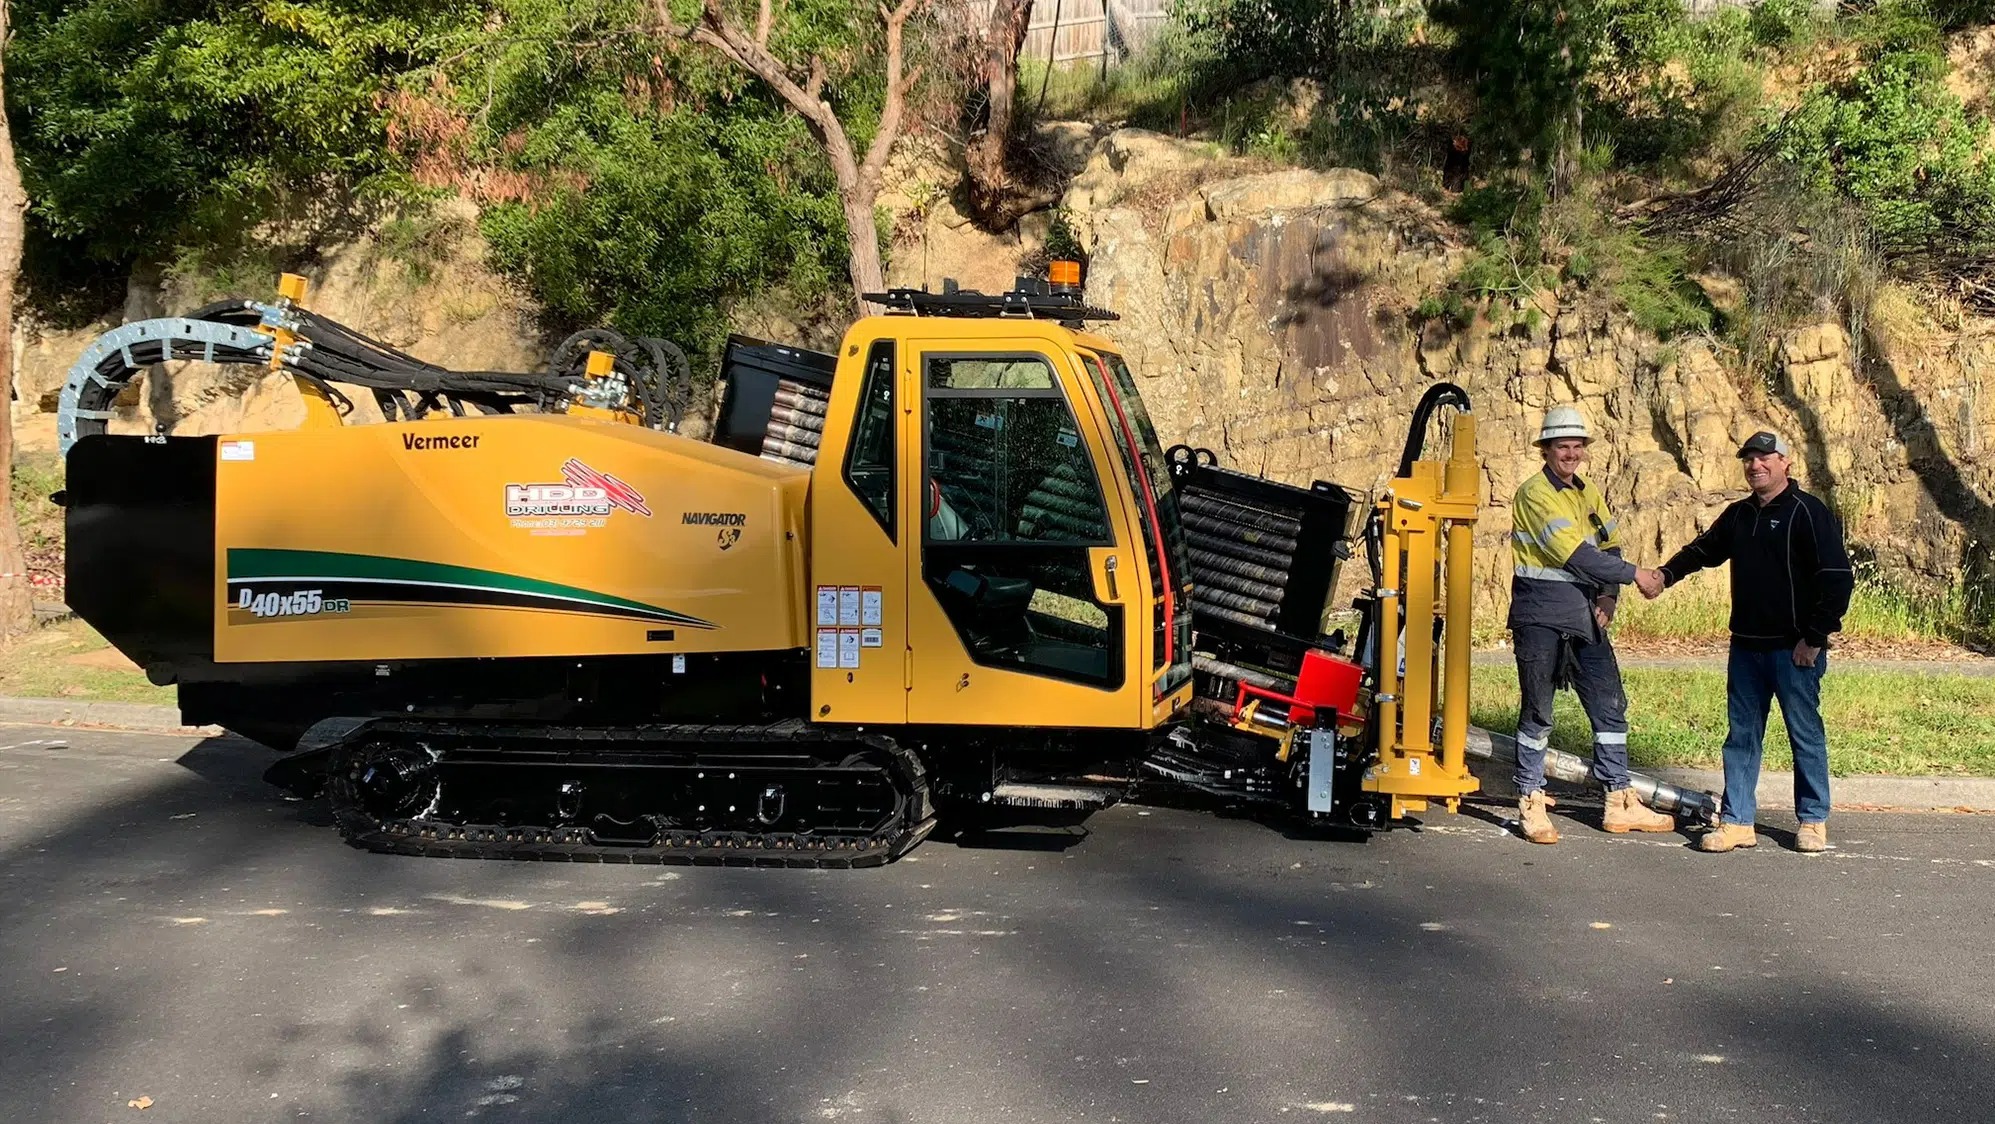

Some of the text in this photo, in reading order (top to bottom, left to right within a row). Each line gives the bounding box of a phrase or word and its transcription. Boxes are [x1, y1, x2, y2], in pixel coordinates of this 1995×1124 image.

[402, 432, 480, 450] Vermeer
[508, 486, 607, 501] HDD
[508, 503, 608, 514] DRILLING
[681, 512, 746, 526] NAVIGATOR
[239, 588, 350, 617] D40x55 DR
